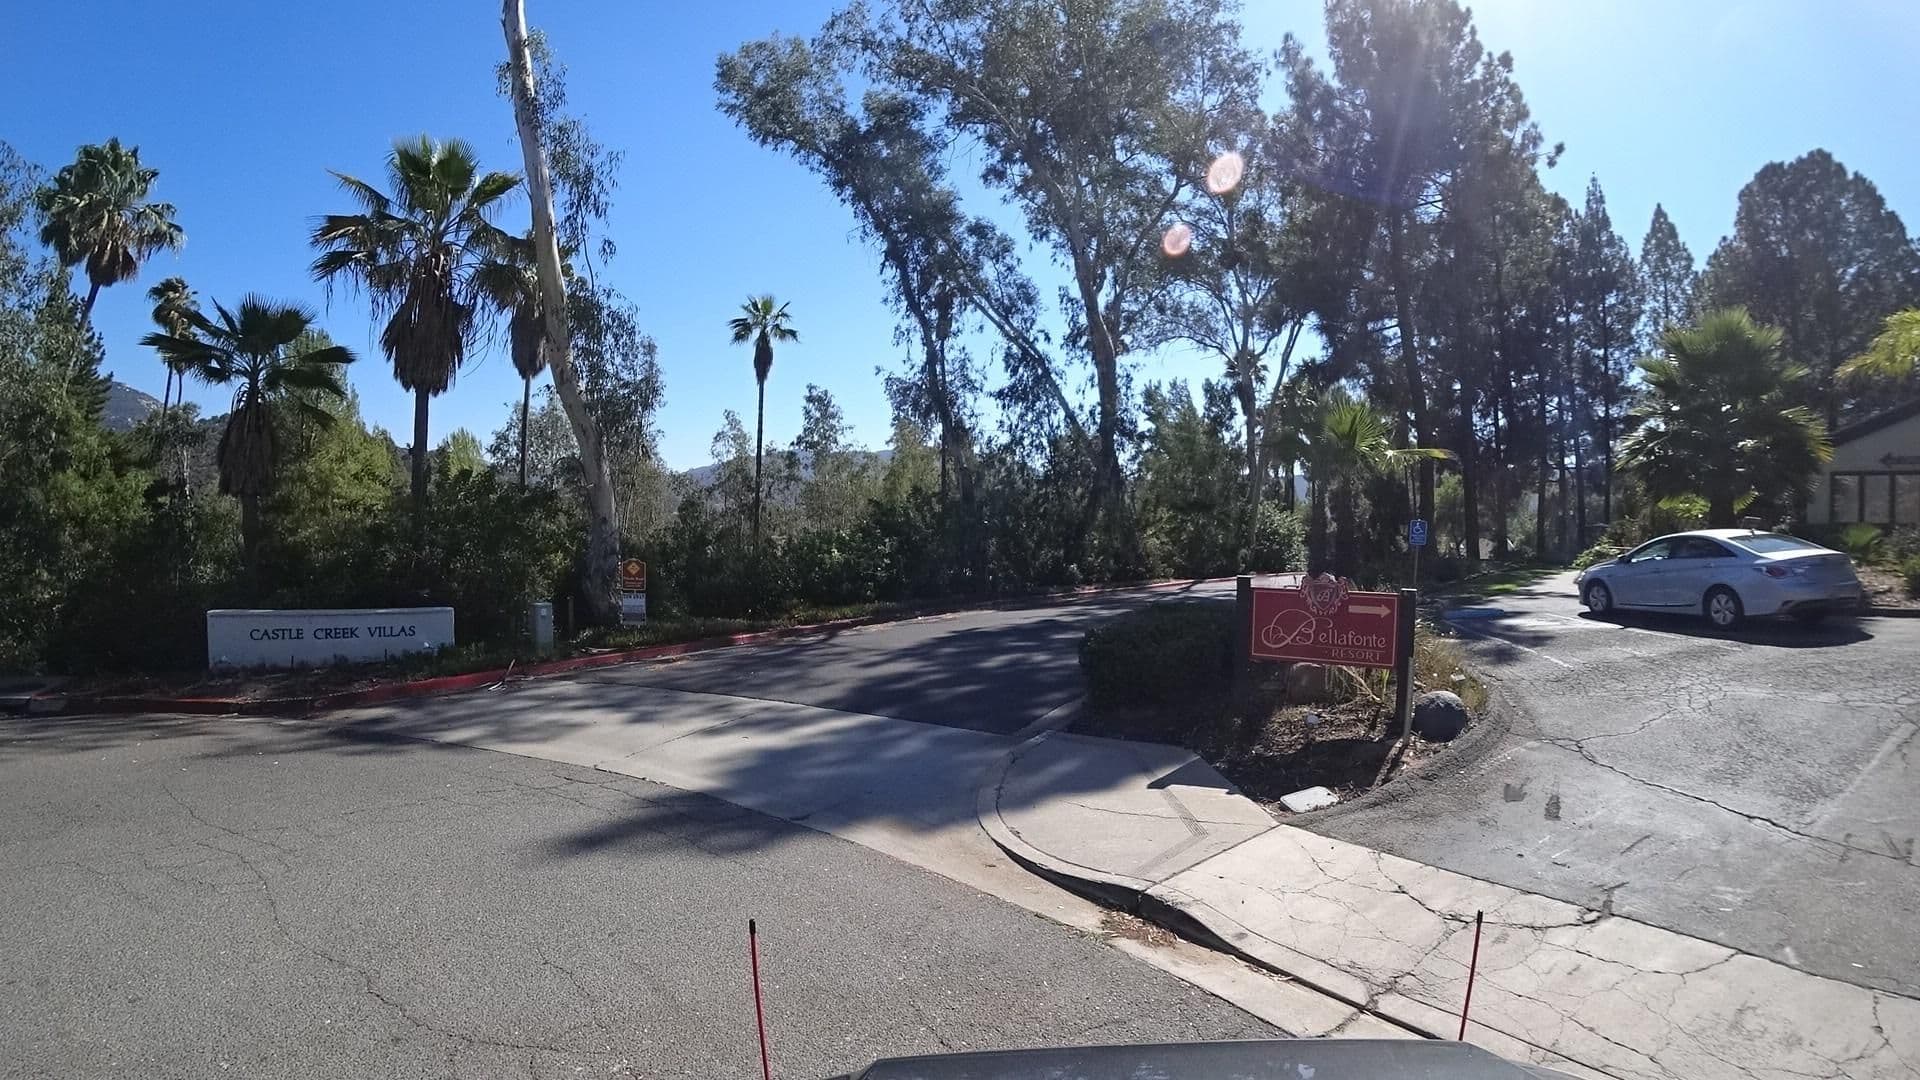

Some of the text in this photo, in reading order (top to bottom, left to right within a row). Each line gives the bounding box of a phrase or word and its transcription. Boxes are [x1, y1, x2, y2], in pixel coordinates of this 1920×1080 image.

[250, 625, 416, 641] CASTLE CREEK VILLAS
[1261, 608, 1387, 649] Bellafonte
[1331, 648, 1382, 662] RESORT
